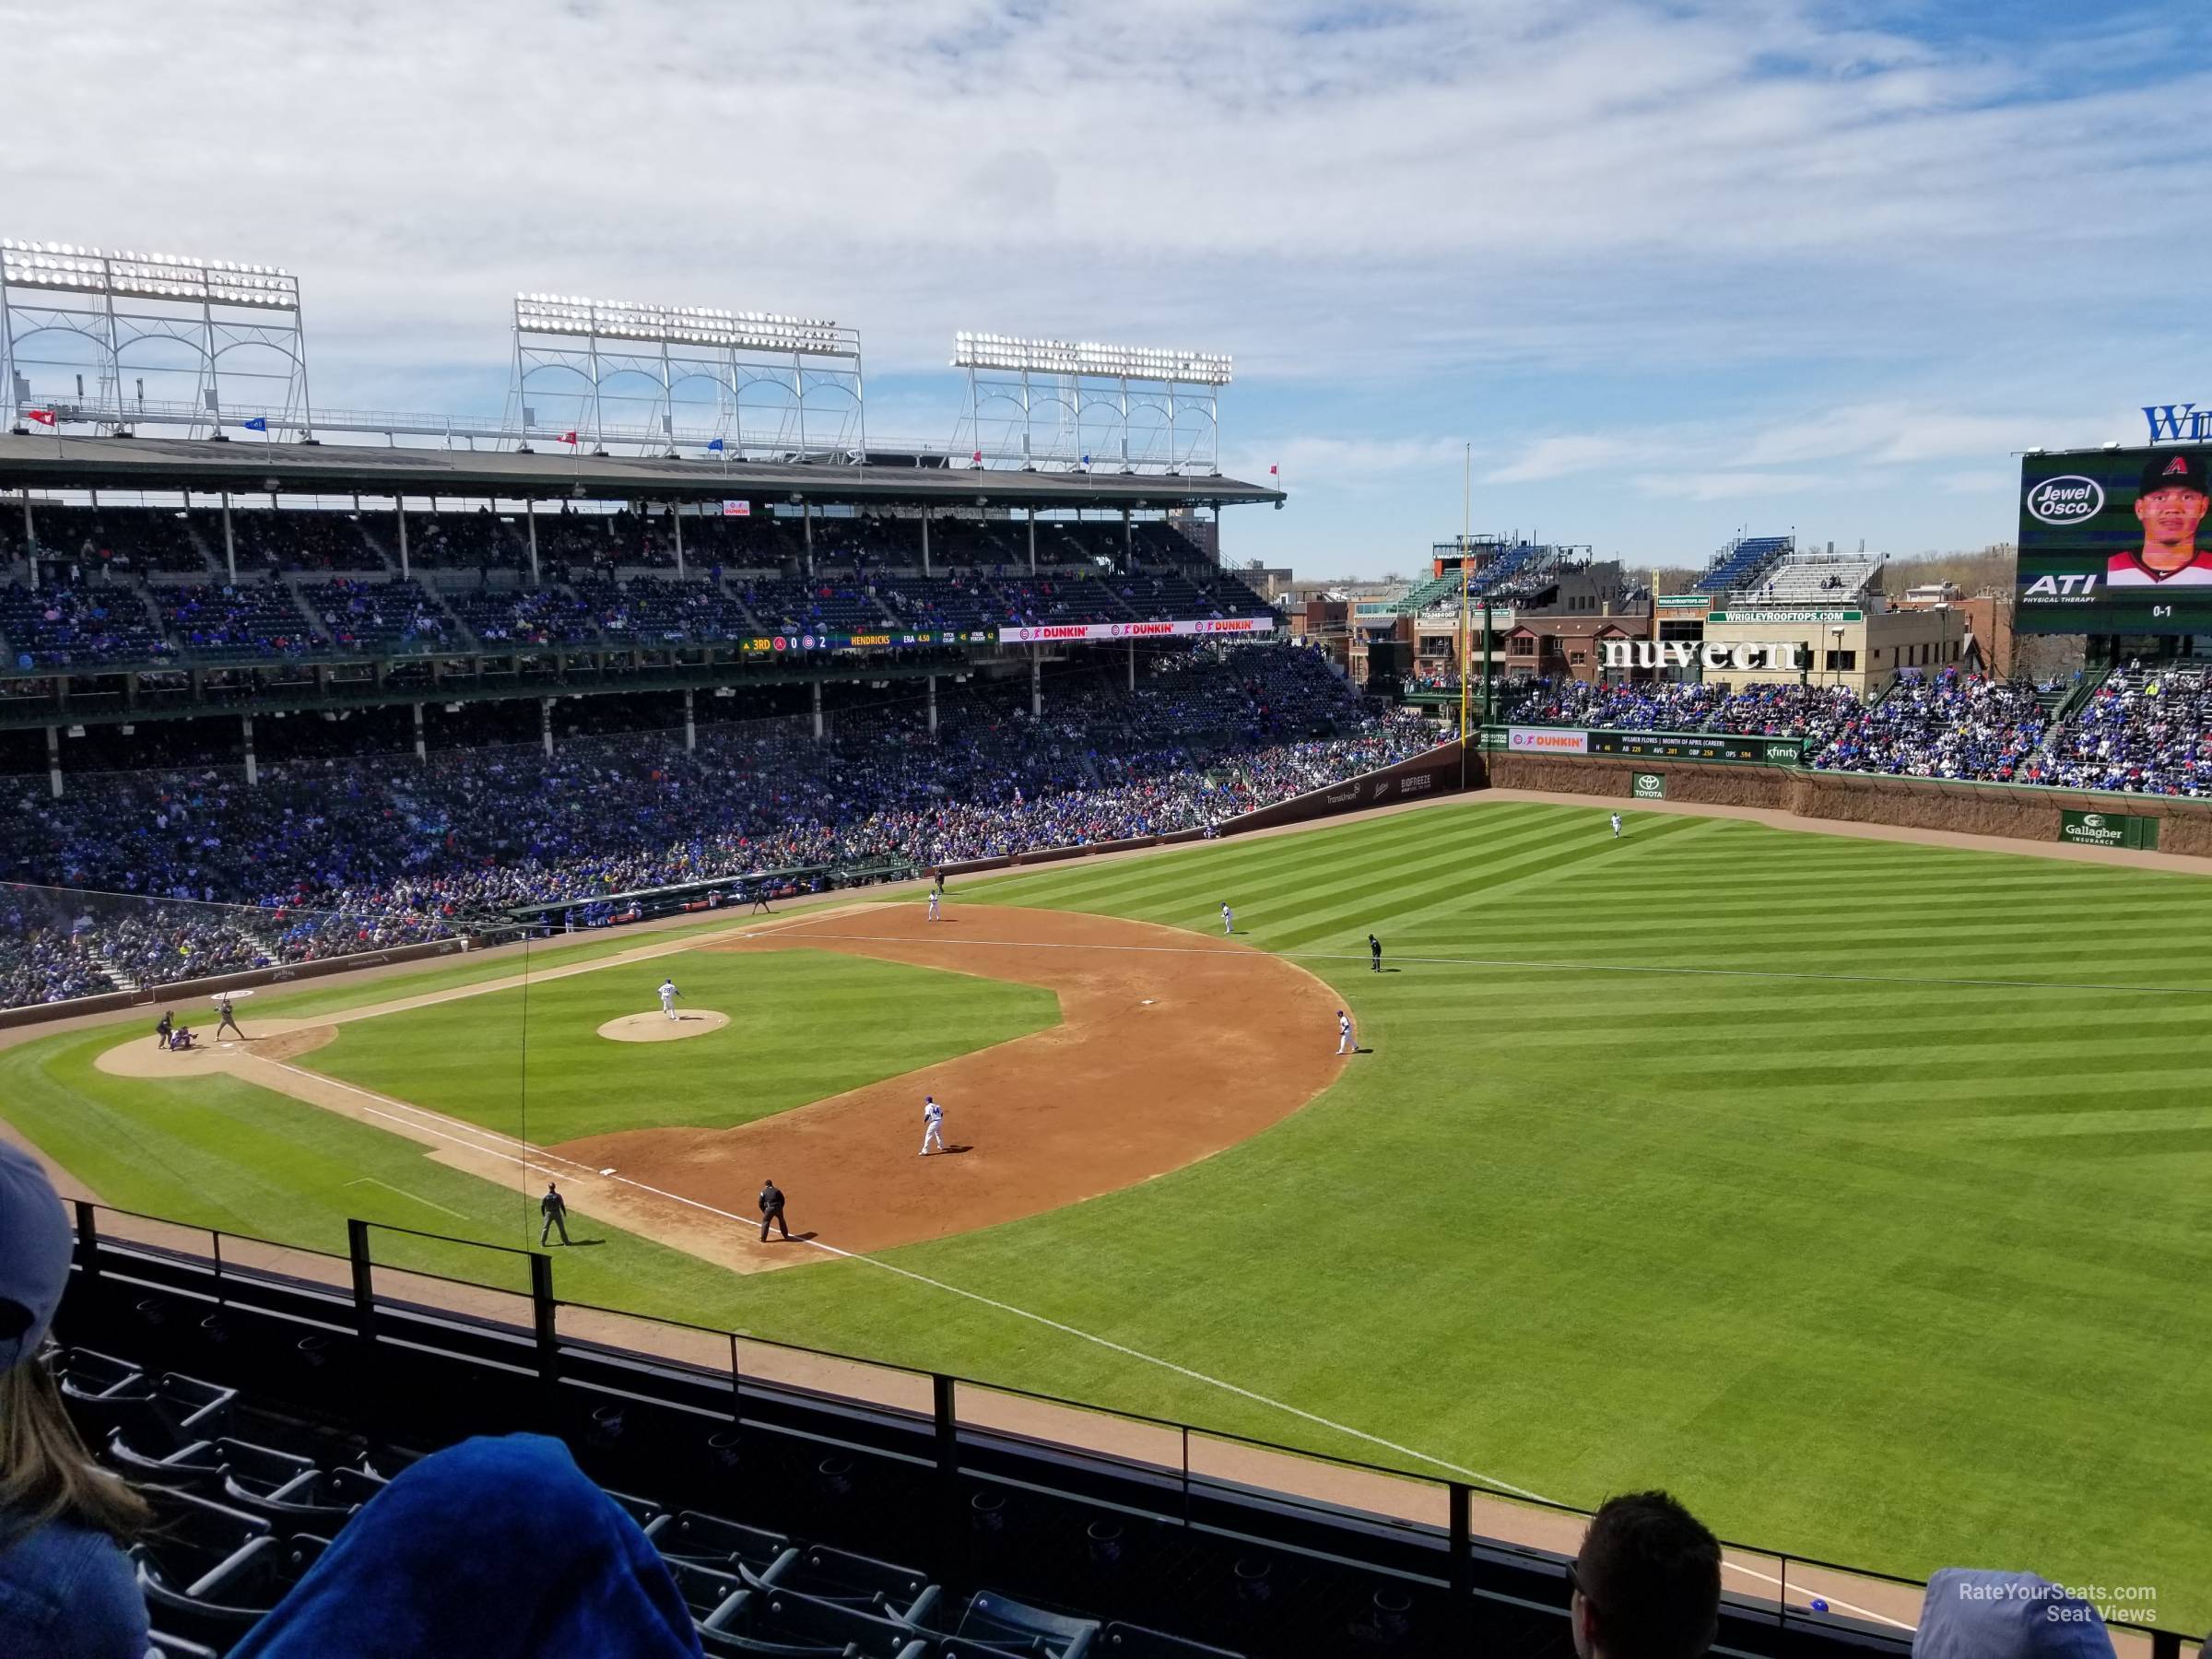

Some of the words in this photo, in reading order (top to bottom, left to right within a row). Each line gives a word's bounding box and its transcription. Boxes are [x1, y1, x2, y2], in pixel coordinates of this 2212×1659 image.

[2038, 485, 2091, 500] Jewel
[2041, 500, 2088, 515] Osco
[2024, 574, 2097, 595] ATI
[2153, 606, 2171, 617] 0-1
[1133, 623, 1174, 635] DUNKIN'
[1215, 620, 1253, 631] DUNKIN'
[1043, 627, 1088, 639] DUNKIN'
[753, 640, 771, 650] 3RD
[791, 637, 797, 648] 0
[819, 637, 826, 648] 2
[852, 635, 889, 645] HENDRICKS
[903, 635, 915, 643] ERA
[918, 634, 930, 642] 4.50
[1603, 641, 1804, 670] nuveen
[1536, 736, 1583, 747] DUNKIN'
[1767, 747, 1798, 759] xfinity
[1401, 774, 1430, 788] BIOFREEZE
[1327, 793, 1357, 804] TransUnion
[1635, 790, 1663, 798] TOYOTA
[2065, 825, 2123, 839] Gallagher
[2072, 836, 2114, 845] INSURANCE
